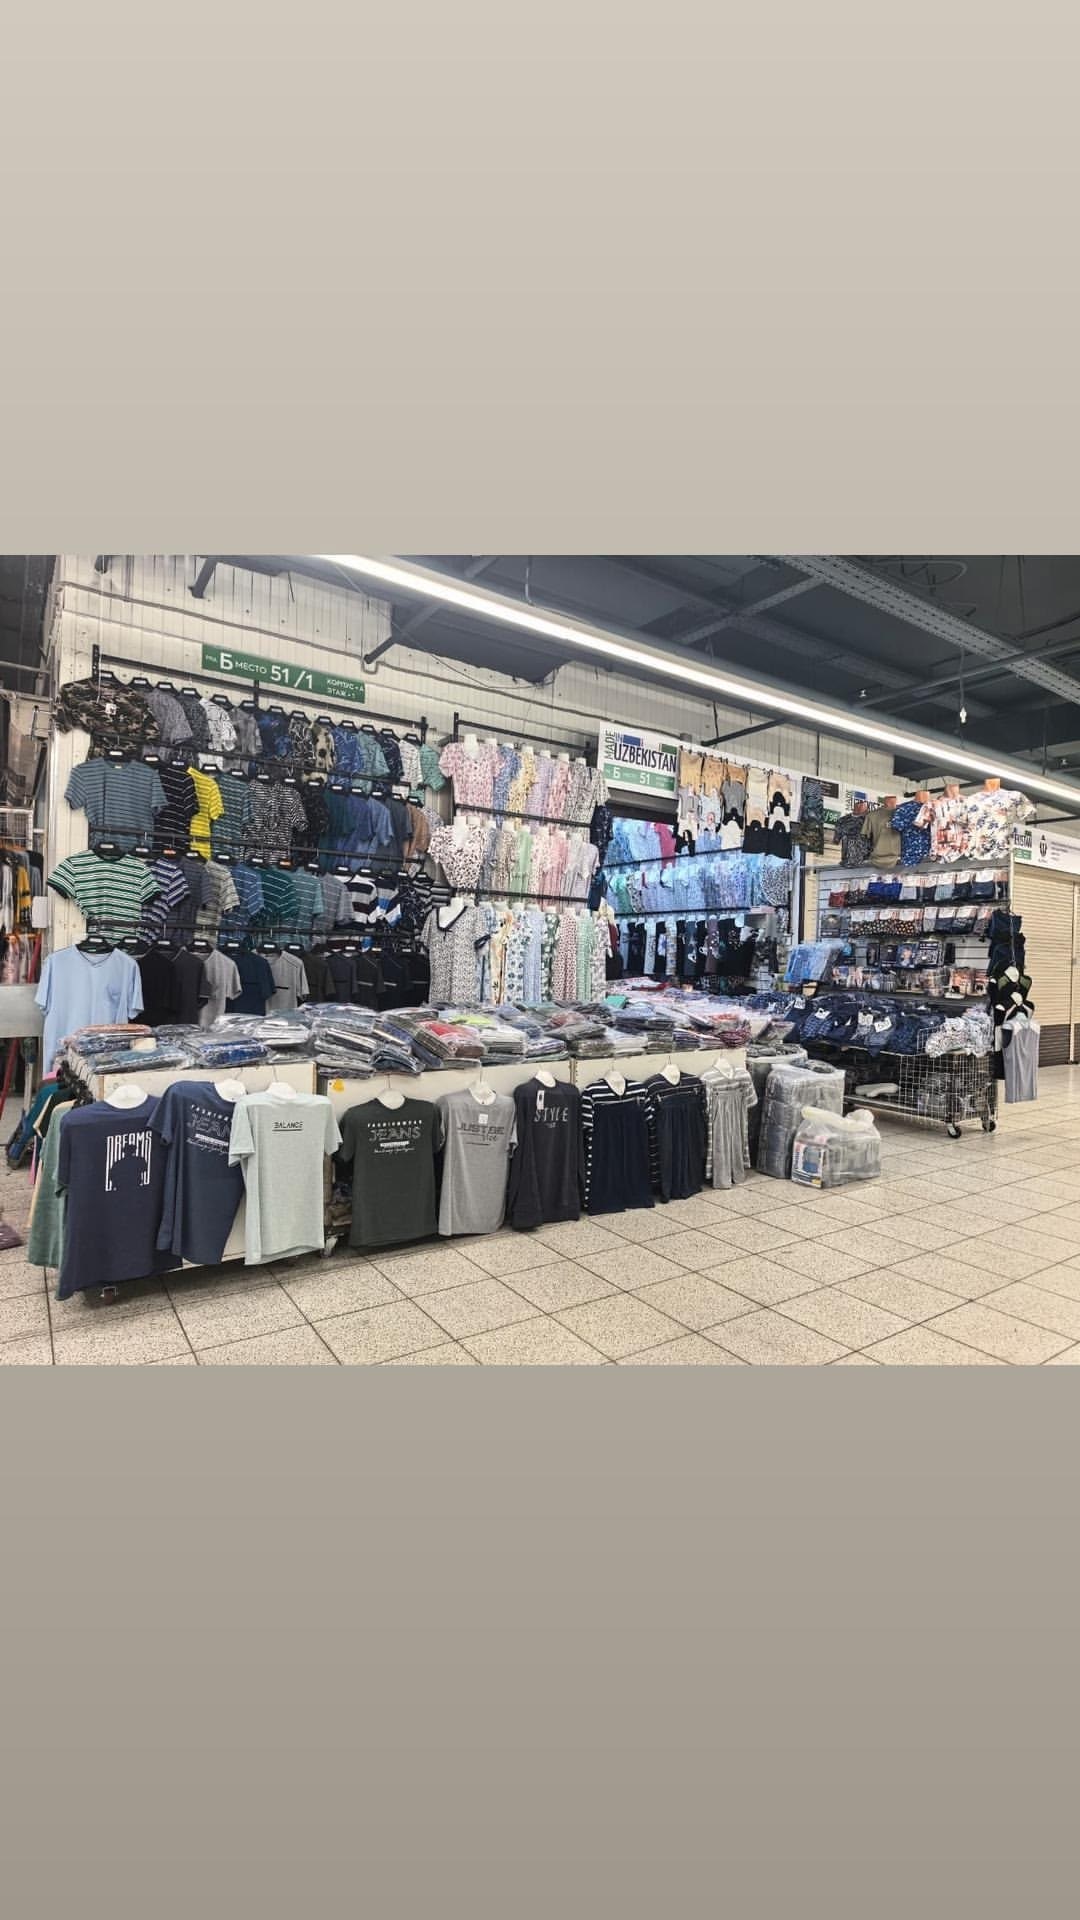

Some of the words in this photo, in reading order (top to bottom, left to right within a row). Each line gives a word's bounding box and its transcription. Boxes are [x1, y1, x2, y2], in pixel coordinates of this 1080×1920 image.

[219, 652, 234, 670] Б
[235, 661, 267, 674] МЕСТО
[604, 730, 615, 760] MADE
[614, 742, 677, 773] UZBEKISTAN
[639, 772, 651, 785] 51
[533, 1106, 569, 1122] STYLE
[187, 1113, 230, 1137] JEAN
[273, 1121, 303, 1129] BALANCE
[457, 1122, 488, 1134] JUST
[369, 1126, 421, 1141] JEANS
